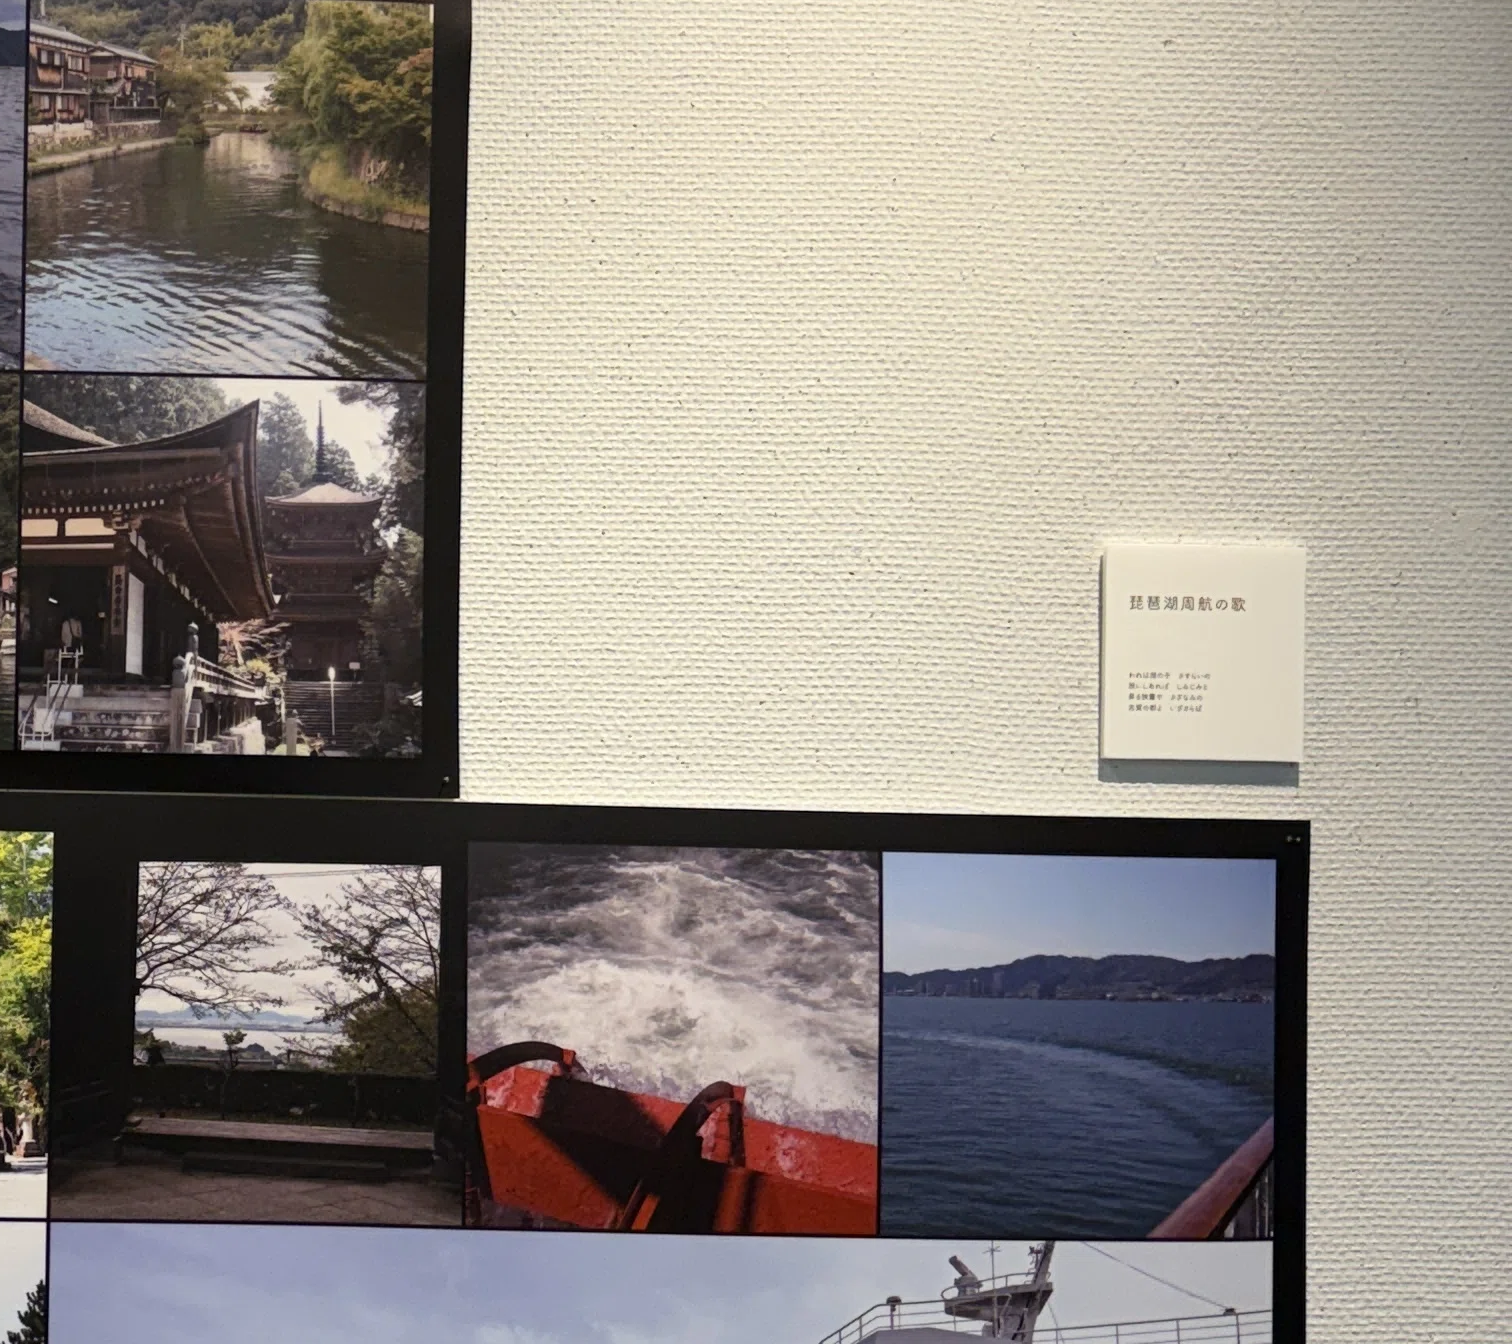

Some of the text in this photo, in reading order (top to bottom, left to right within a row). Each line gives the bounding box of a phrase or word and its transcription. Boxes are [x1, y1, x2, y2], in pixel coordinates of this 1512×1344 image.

[1129, 595, 1246, 612] 琵琶湖周航の歌
